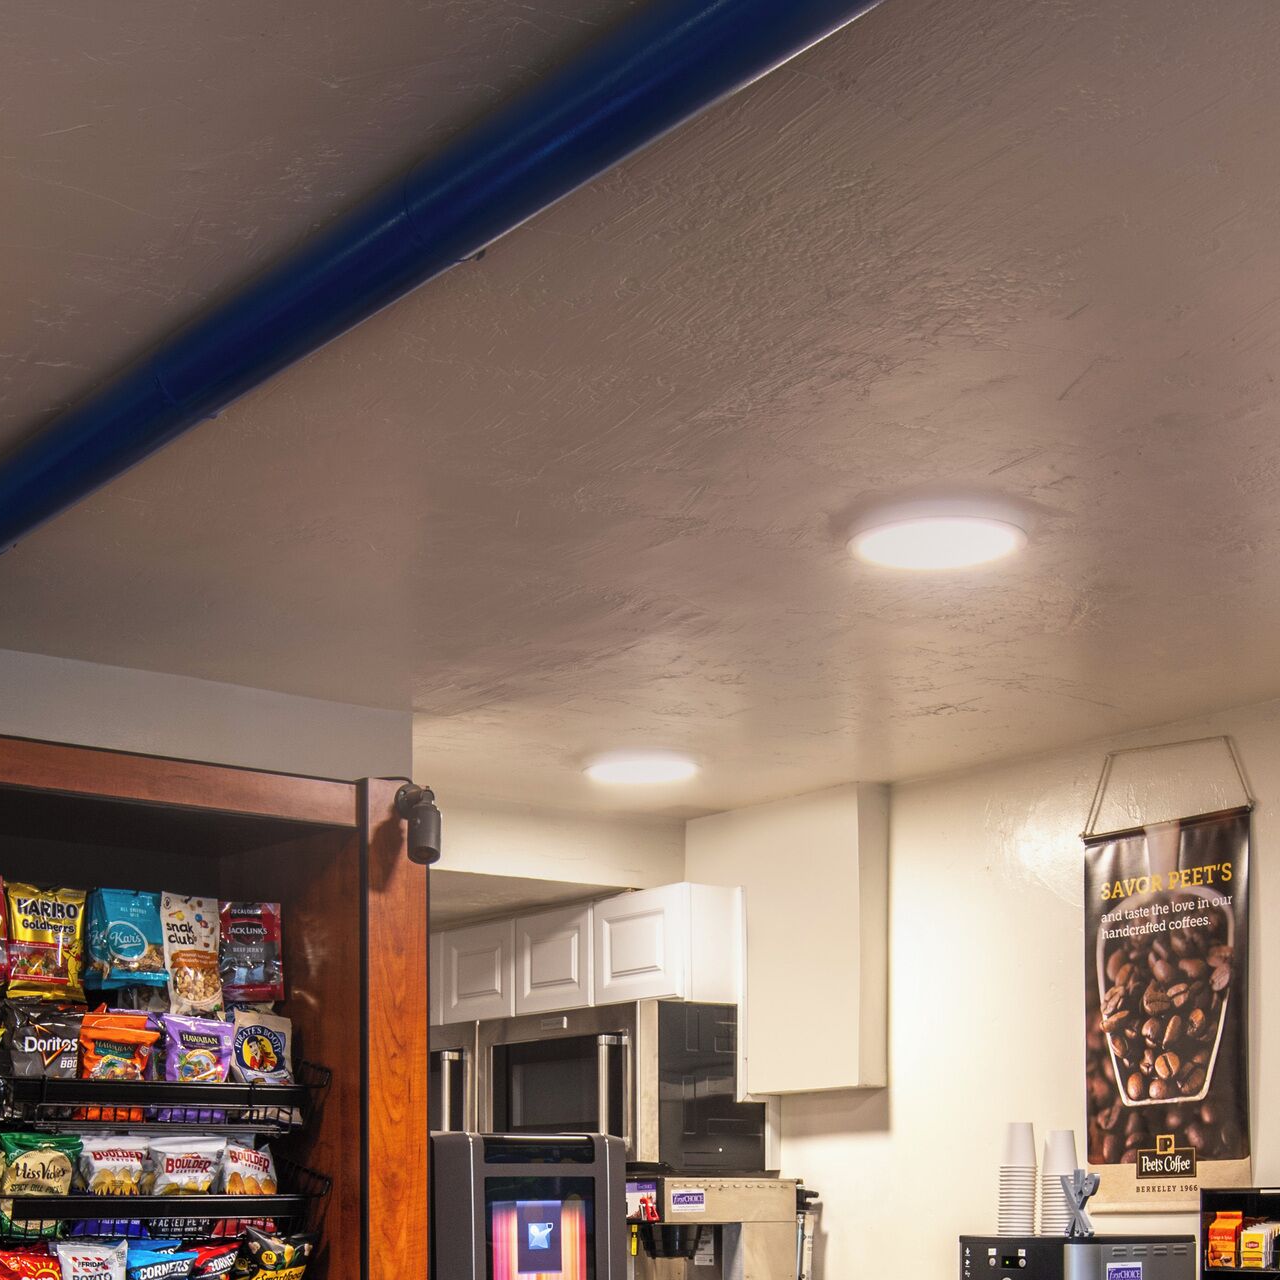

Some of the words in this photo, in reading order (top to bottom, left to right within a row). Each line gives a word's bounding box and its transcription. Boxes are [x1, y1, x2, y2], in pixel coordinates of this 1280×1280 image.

[1101, 869, 1163, 901] SAVOR
[1167, 862, 1233, 890] PEET'S
[16, 898, 79, 920] HARIBO
[1101, 909, 1123, 922] and
[1124, 906, 1150, 920] taste
[1151, 902, 1170, 917] the
[1171, 899, 1196, 914] love
[1198, 898, 1210, 910] in
[1212, 894, 1233, 908] our
[21, 919, 76, 934] Goldbears
[167, 922, 195, 934] snak
[227, 927, 245, 935] JACK
[1100, 920, 1166, 940] handcrafted
[1168, 915, 1212, 931] coffees.
[168, 933, 195, 945] club
[182, 1034, 218, 1045] HAWAIIAN
[234, 1027, 262, 1050] PIRATE'S
[262, 1028, 282, 1052] BOOTY
[92, 1149, 144, 1164] BOULDER
[165, 1156, 212, 1174] BOULDER
[229, 1149, 270, 1174] BOULDER
[1141, 1154, 1164, 1173] Peet's
[1164, 1153, 1192, 1172] Coffee
[1135, 1185, 1178, 1193] BERKELEY
[1180, 1184, 1199, 1192] 1966
